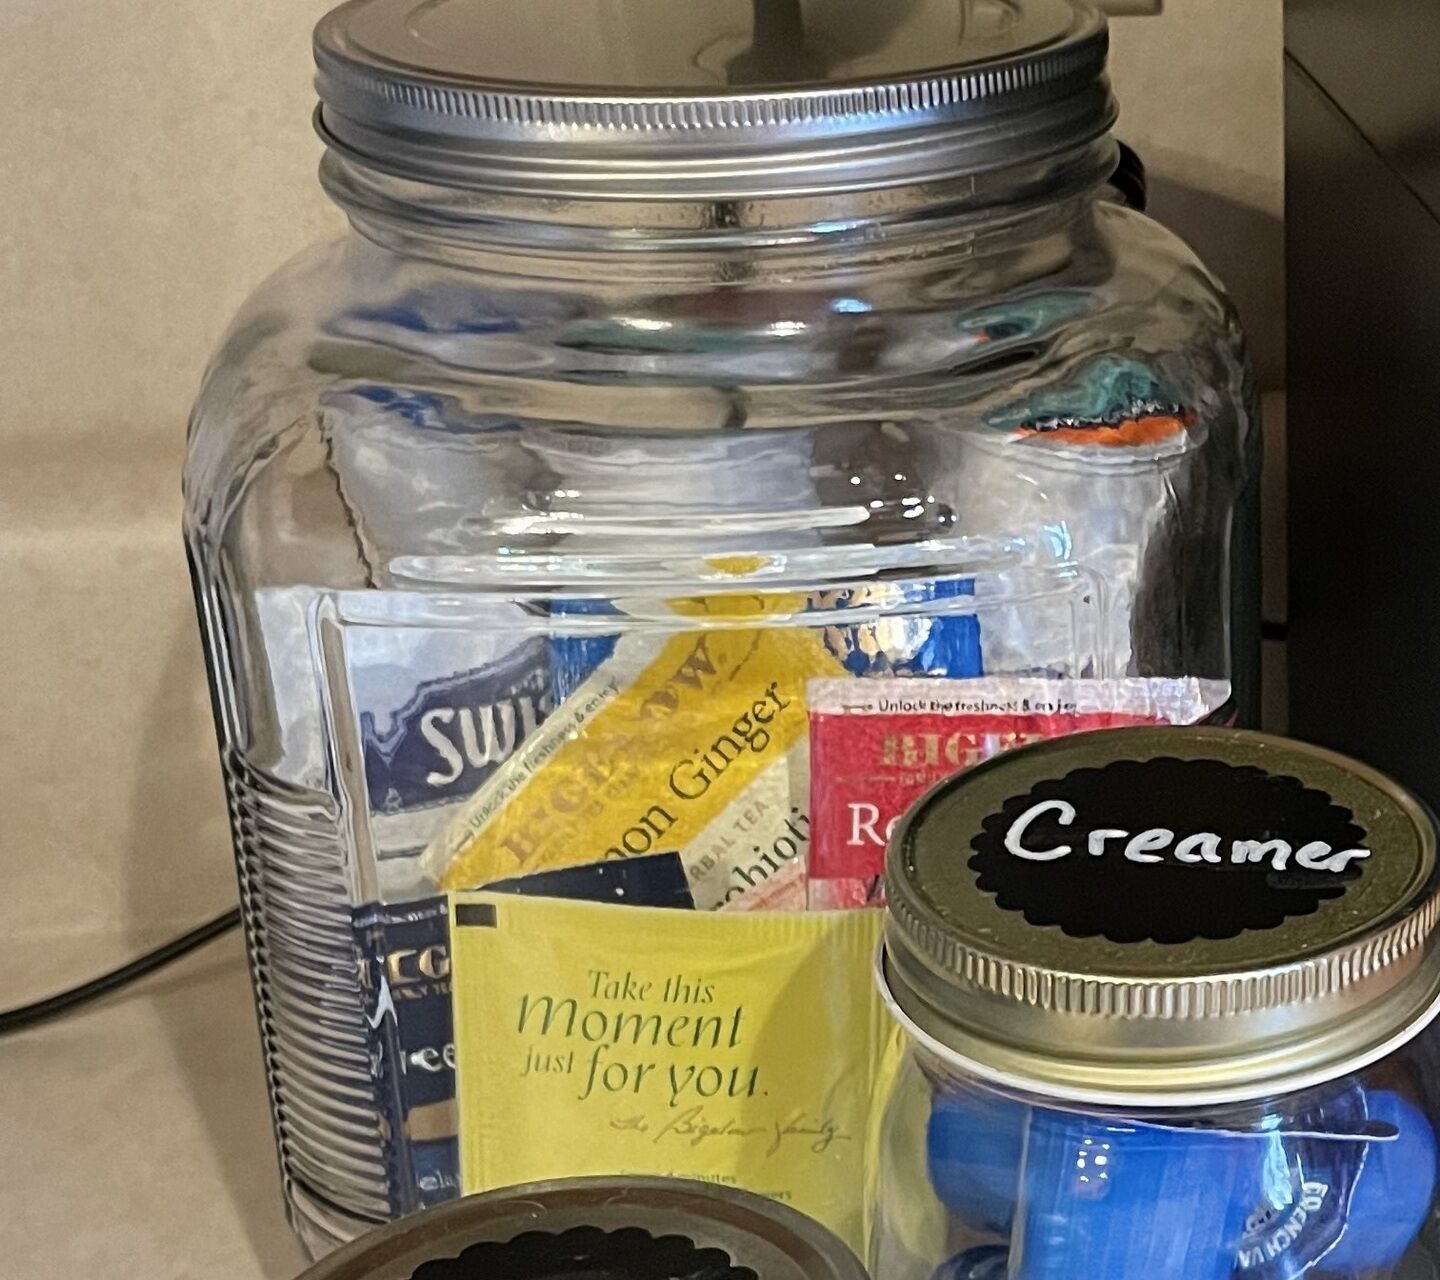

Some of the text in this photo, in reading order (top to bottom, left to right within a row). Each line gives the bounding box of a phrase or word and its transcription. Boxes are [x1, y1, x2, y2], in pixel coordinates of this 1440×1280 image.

[878, 697, 927, 714] Unlock
[668, 681, 792, 801] Ginger
[733, 800, 770, 833] TEA
[1004, 798, 1372, 873] Creamer
[588, 969, 716, 1005] Take this
[519, 1044, 769, 1108] just for you.
